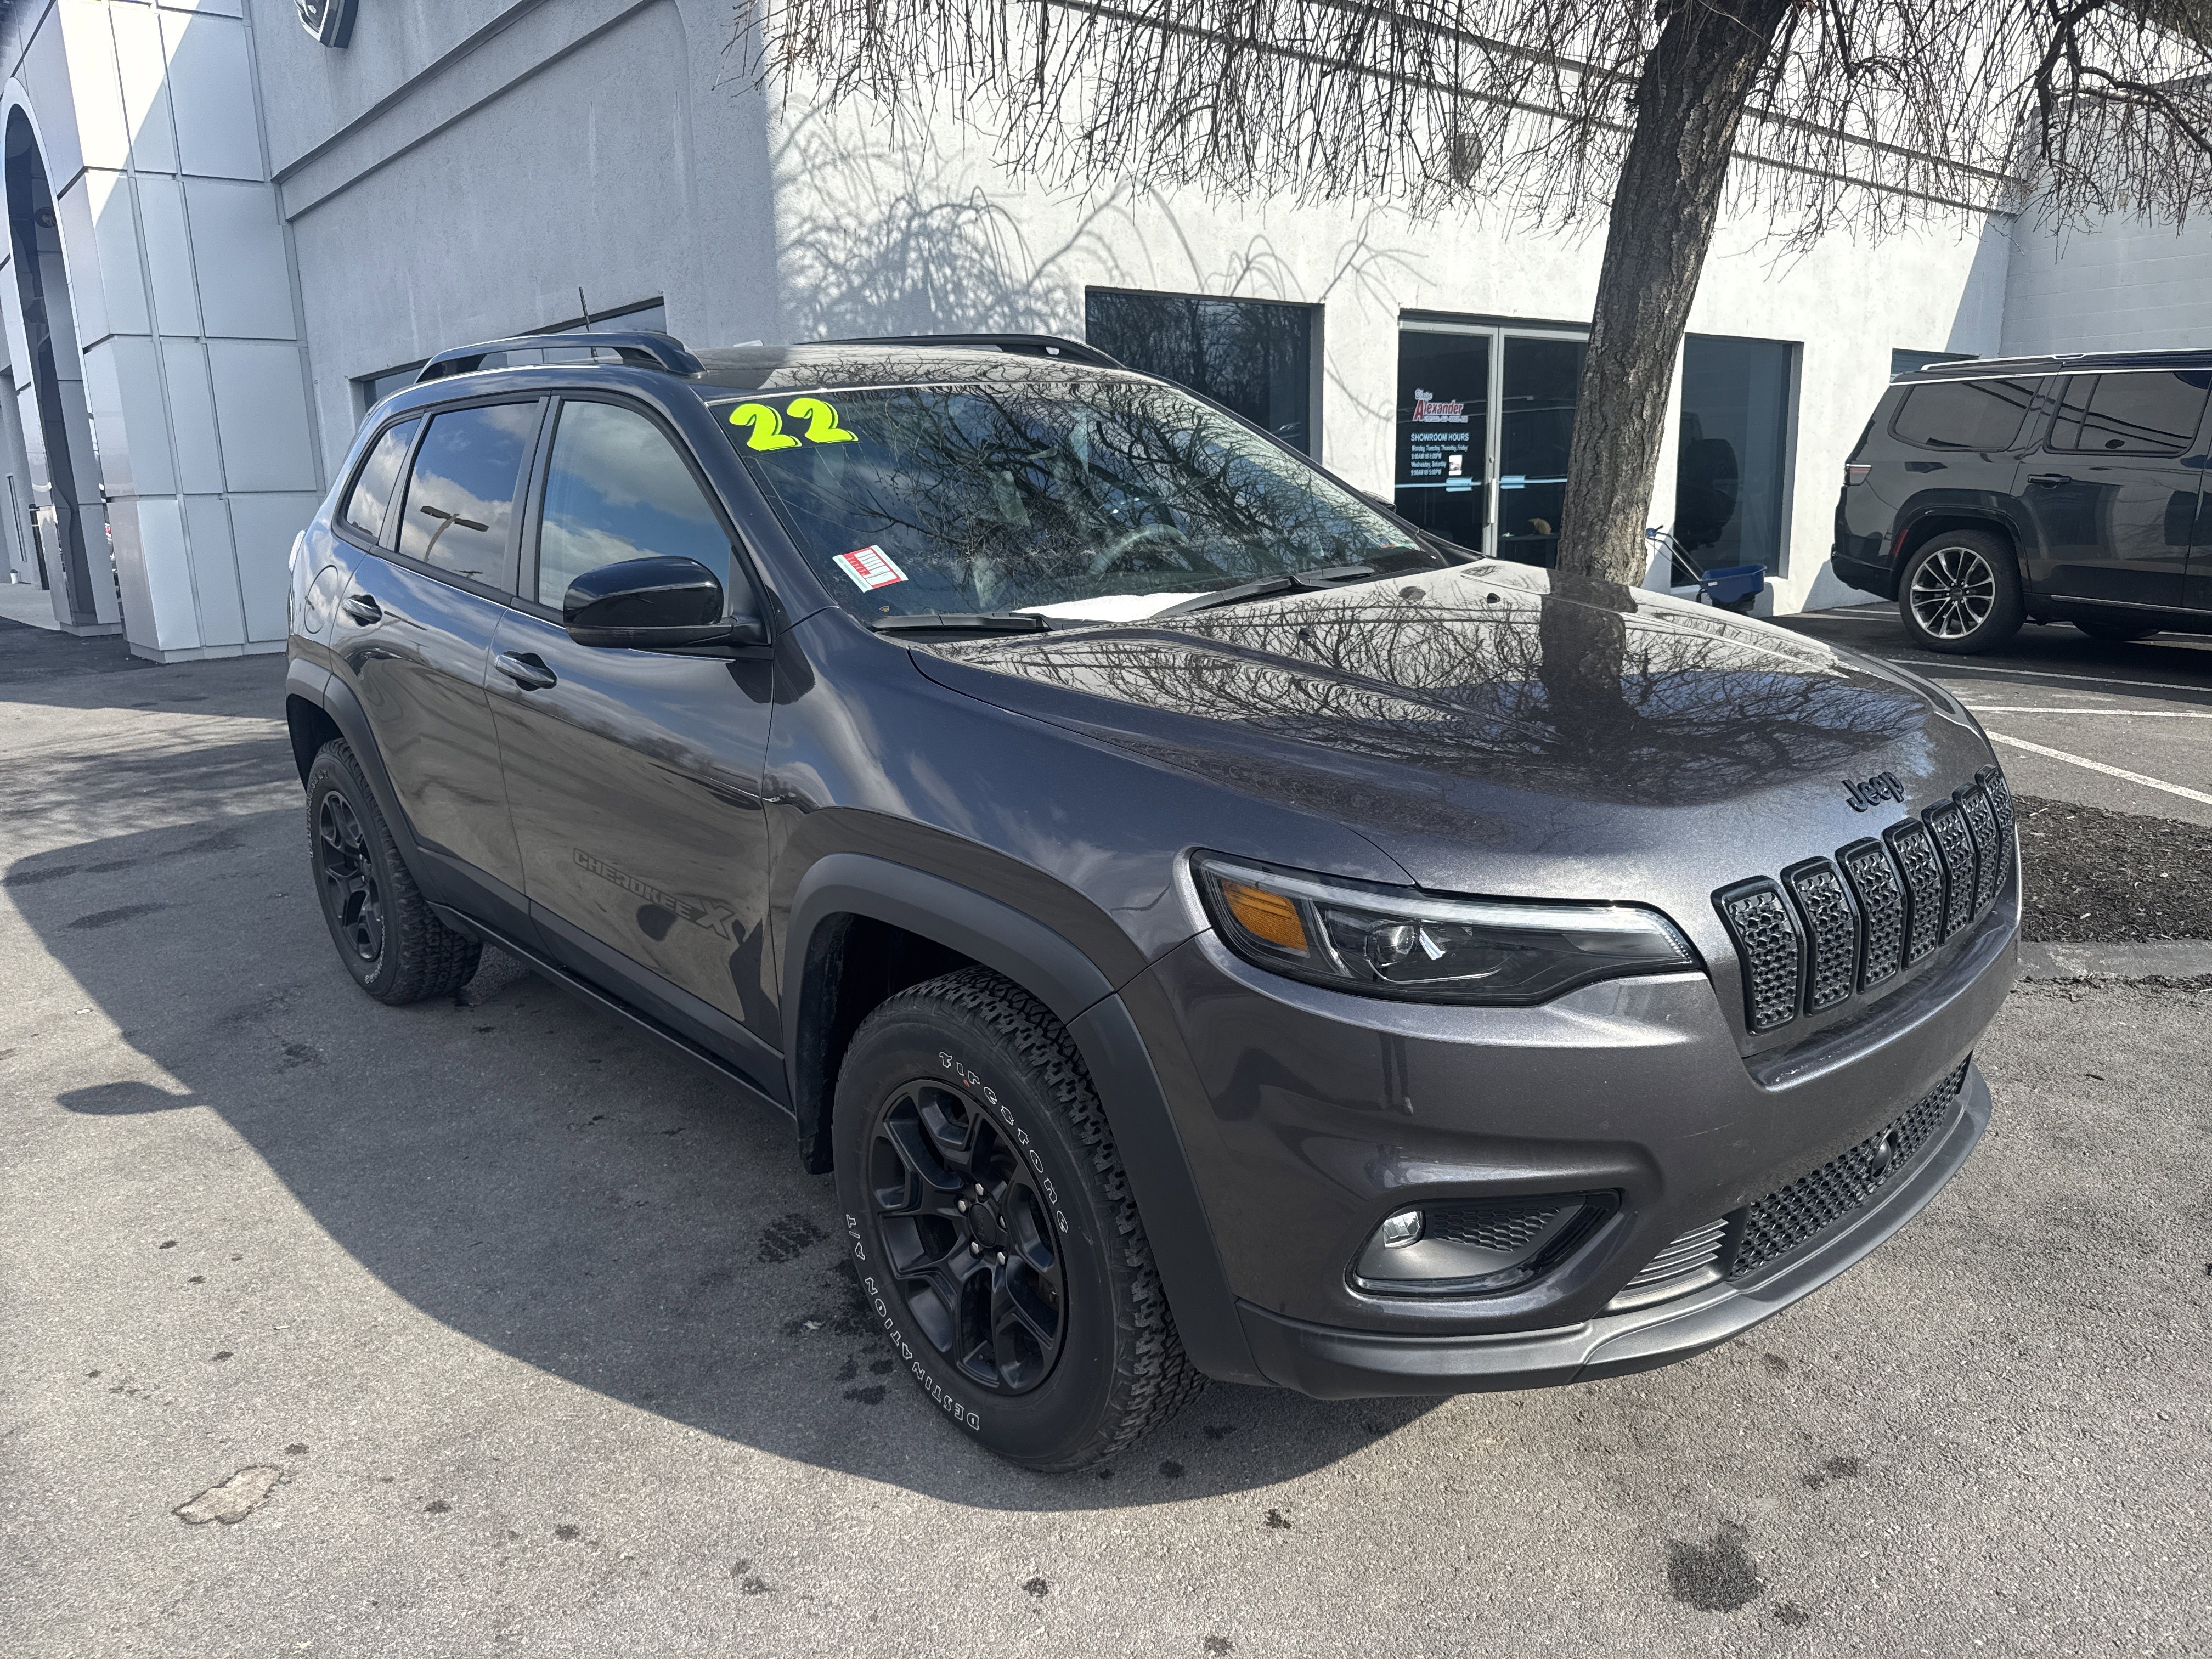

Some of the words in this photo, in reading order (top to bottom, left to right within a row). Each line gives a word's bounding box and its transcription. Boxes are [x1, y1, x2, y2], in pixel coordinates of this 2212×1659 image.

[729, 397, 859, 452] 22
[1412, 399, 1464, 422] Alexander
[1448, 433, 1469, 441] HOURS
[1457, 444, 1468, 453] Friday
[1841, 771, 1904, 812] Jeep
[845, 1214, 866, 1261] A/T
[865, 1277, 980, 1431] DESTINATION
